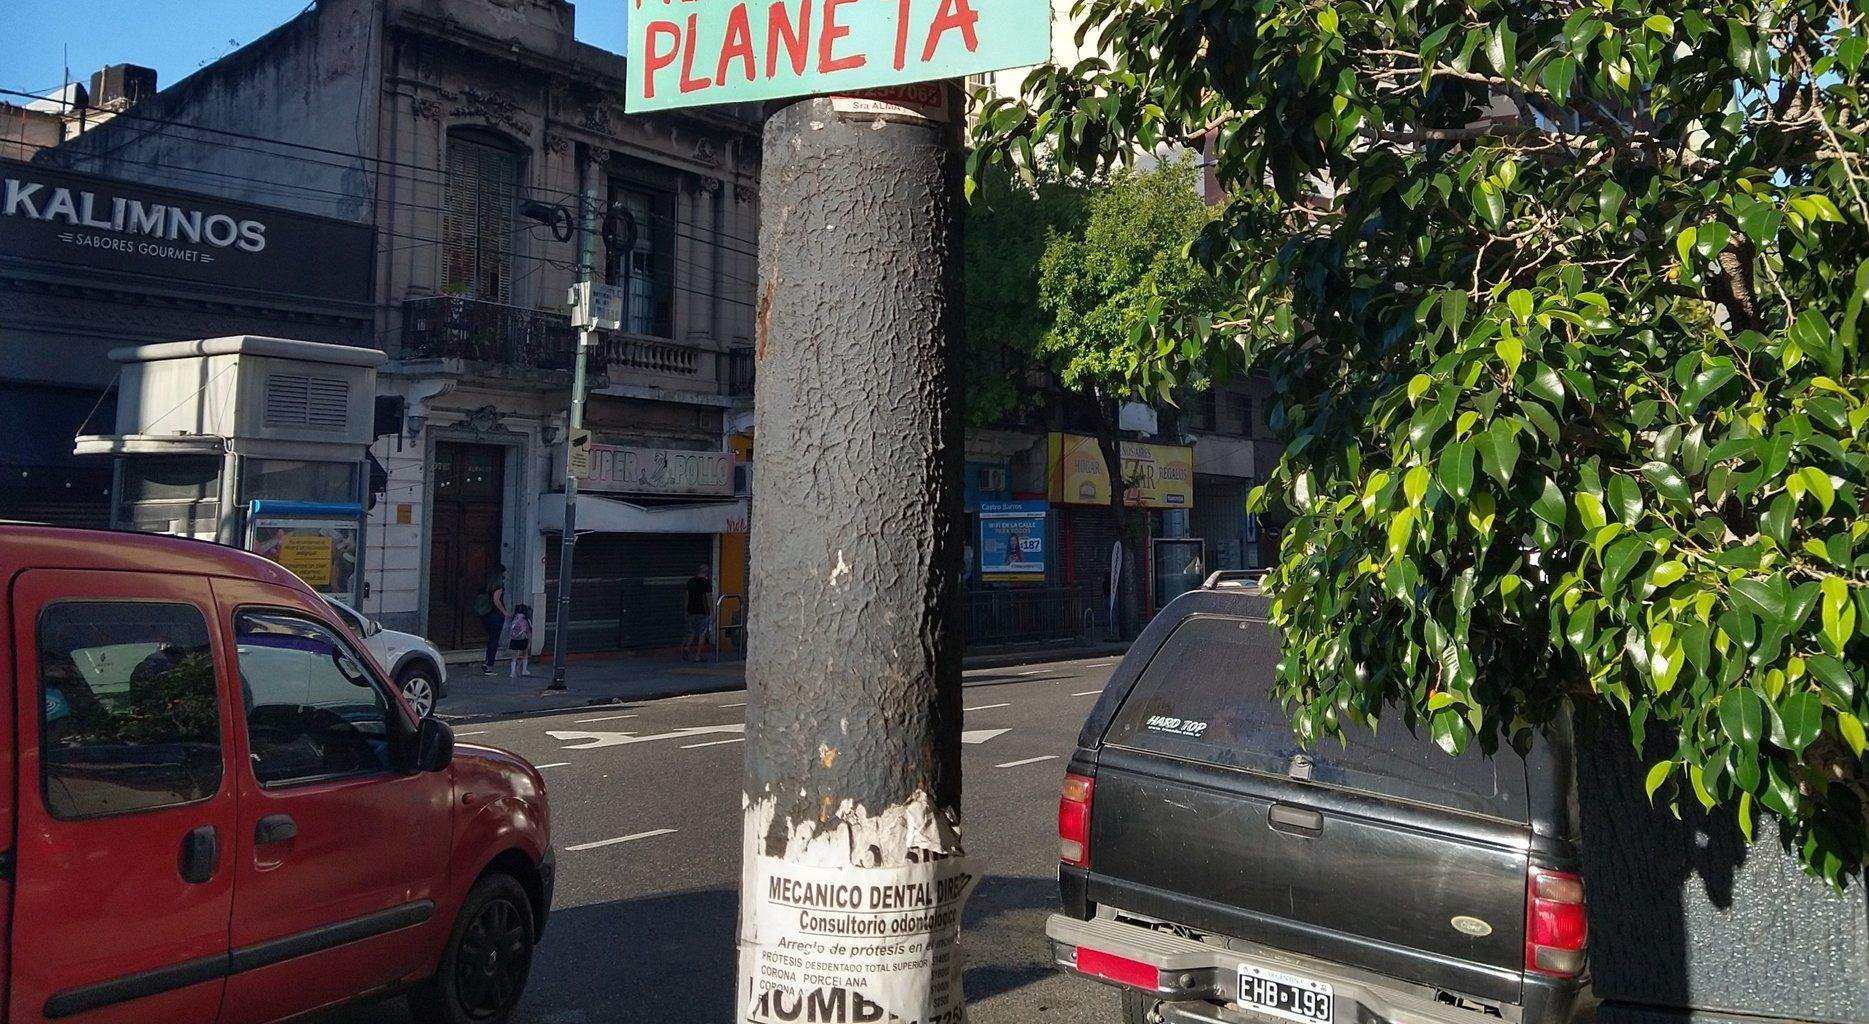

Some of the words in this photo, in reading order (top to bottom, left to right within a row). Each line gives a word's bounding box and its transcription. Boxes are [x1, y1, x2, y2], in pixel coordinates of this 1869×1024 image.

[1, 178, 267, 253] KALIMNOS
[76, 233, 134, 253] SABORES
[138, 242, 198, 262] GOURMET
[582, 448, 638, 483] UPER
[1146, 715, 1181, 729] HARD
[1180, 720, 1208, 733] TOP
[768, 876, 863, 909] MECANICO
[869, 880, 933, 910] DENTAL
[799, 910, 886, 935] Consultorio
[829, 942, 847, 955] de
[850, 939, 906, 958] prótesis
[908, 942, 923, 954] en
[760, 964, 797, 982] CORONA
[805, 960, 863, 973] DESDENTADO
[865, 962, 891, 973] TOTAL
[892, 959, 929, 972] SUPERIOR
[1240, 975, 1278, 1007] EHB
[1290, 986, 1329, 1020] 193
